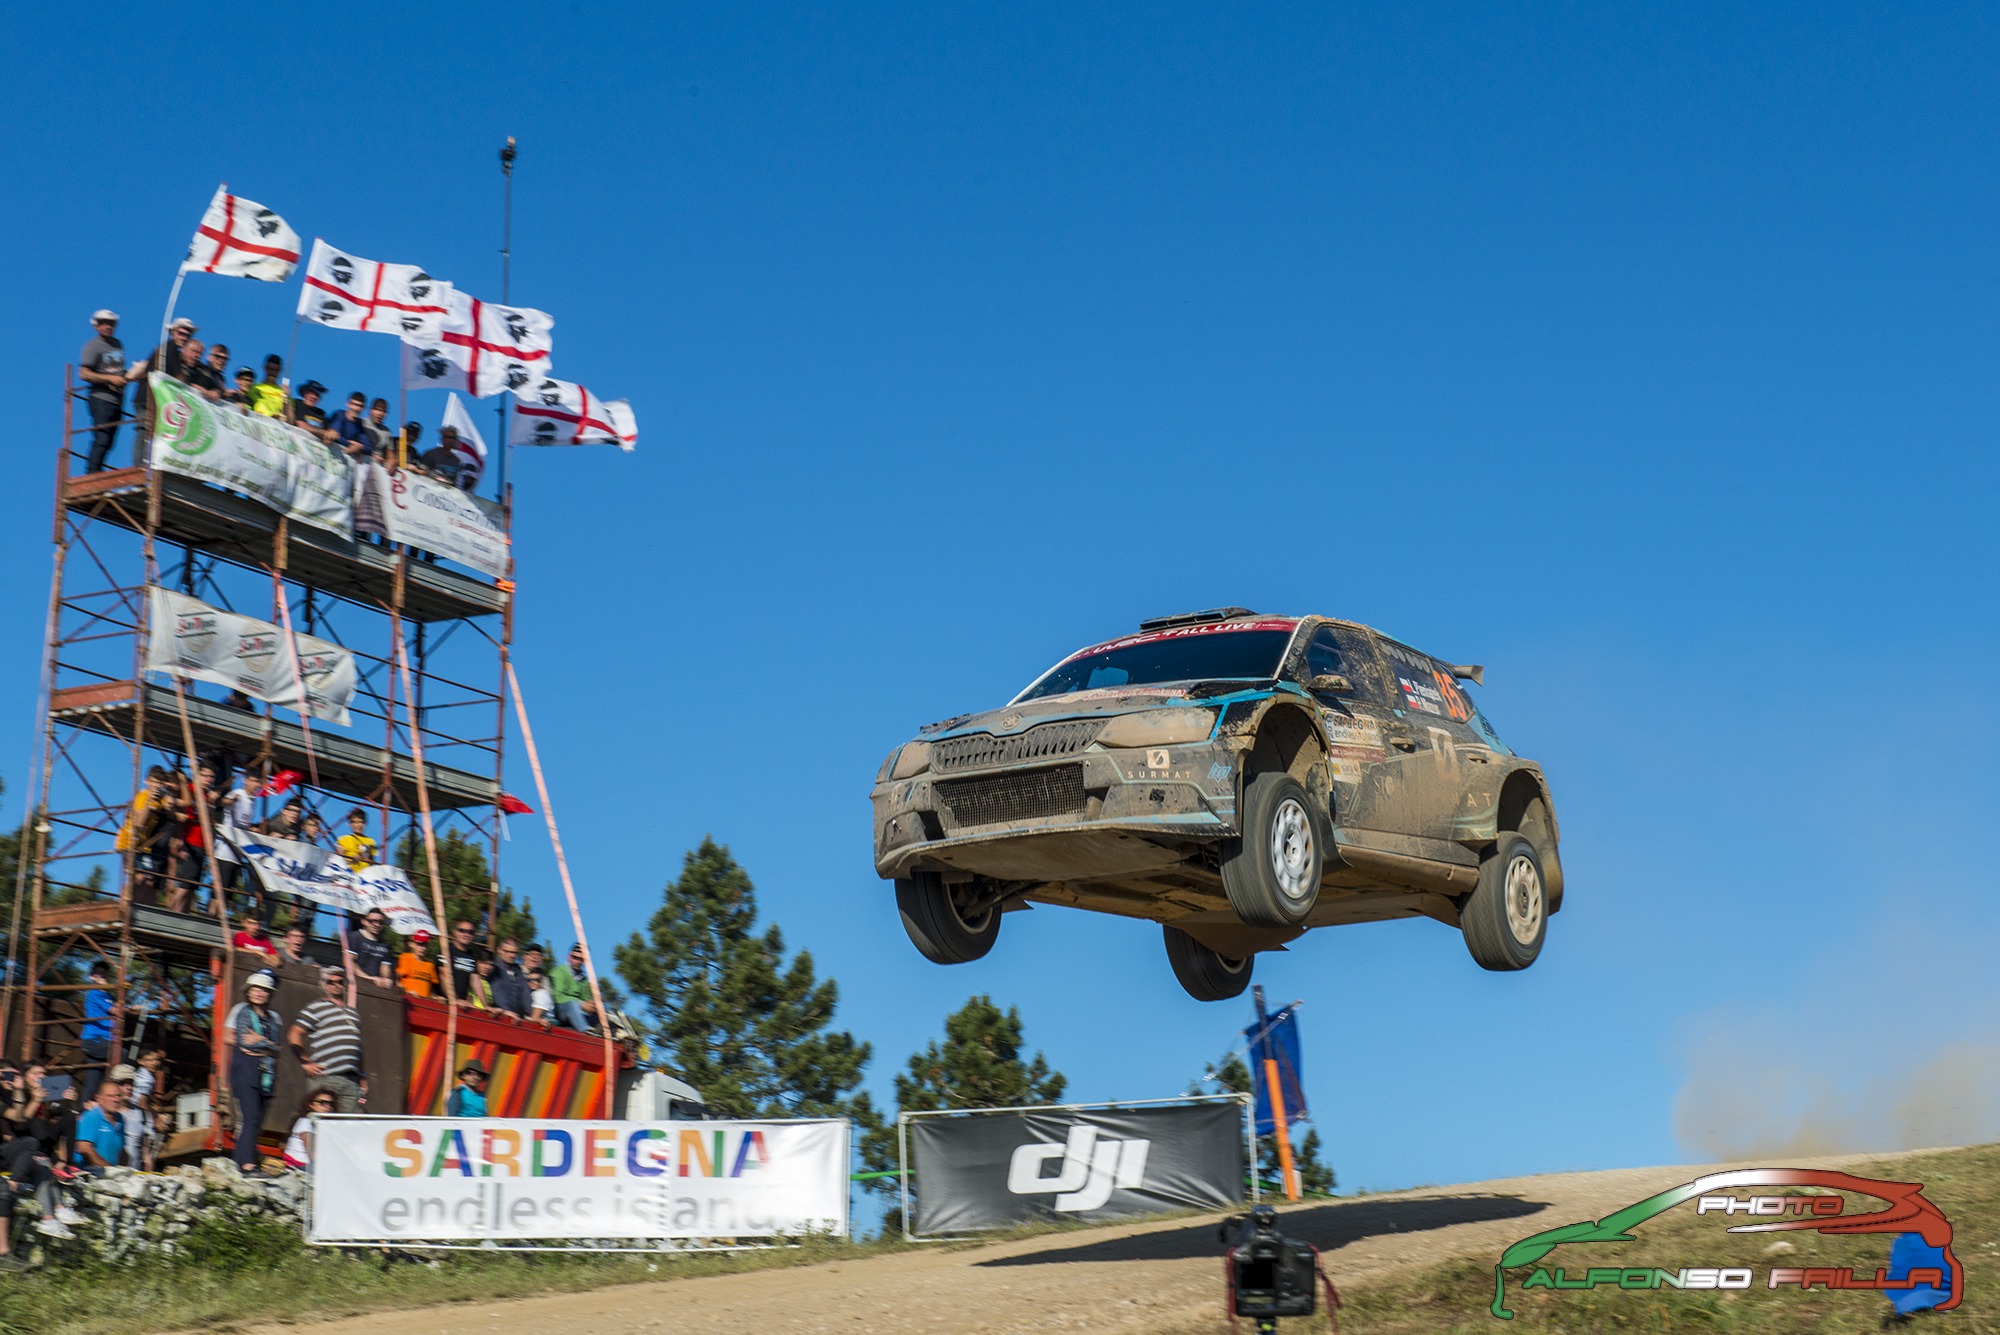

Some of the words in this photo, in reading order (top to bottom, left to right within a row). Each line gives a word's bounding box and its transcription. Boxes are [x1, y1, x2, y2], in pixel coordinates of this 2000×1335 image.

[1176, 626, 1208, 637] ALL
[1214, 622, 1256, 631] LIVE
[1127, 770, 1191, 779] SURMAT
[384, 1129, 770, 1178] SARDEGNA
[382, 1183, 593, 1232] endless
